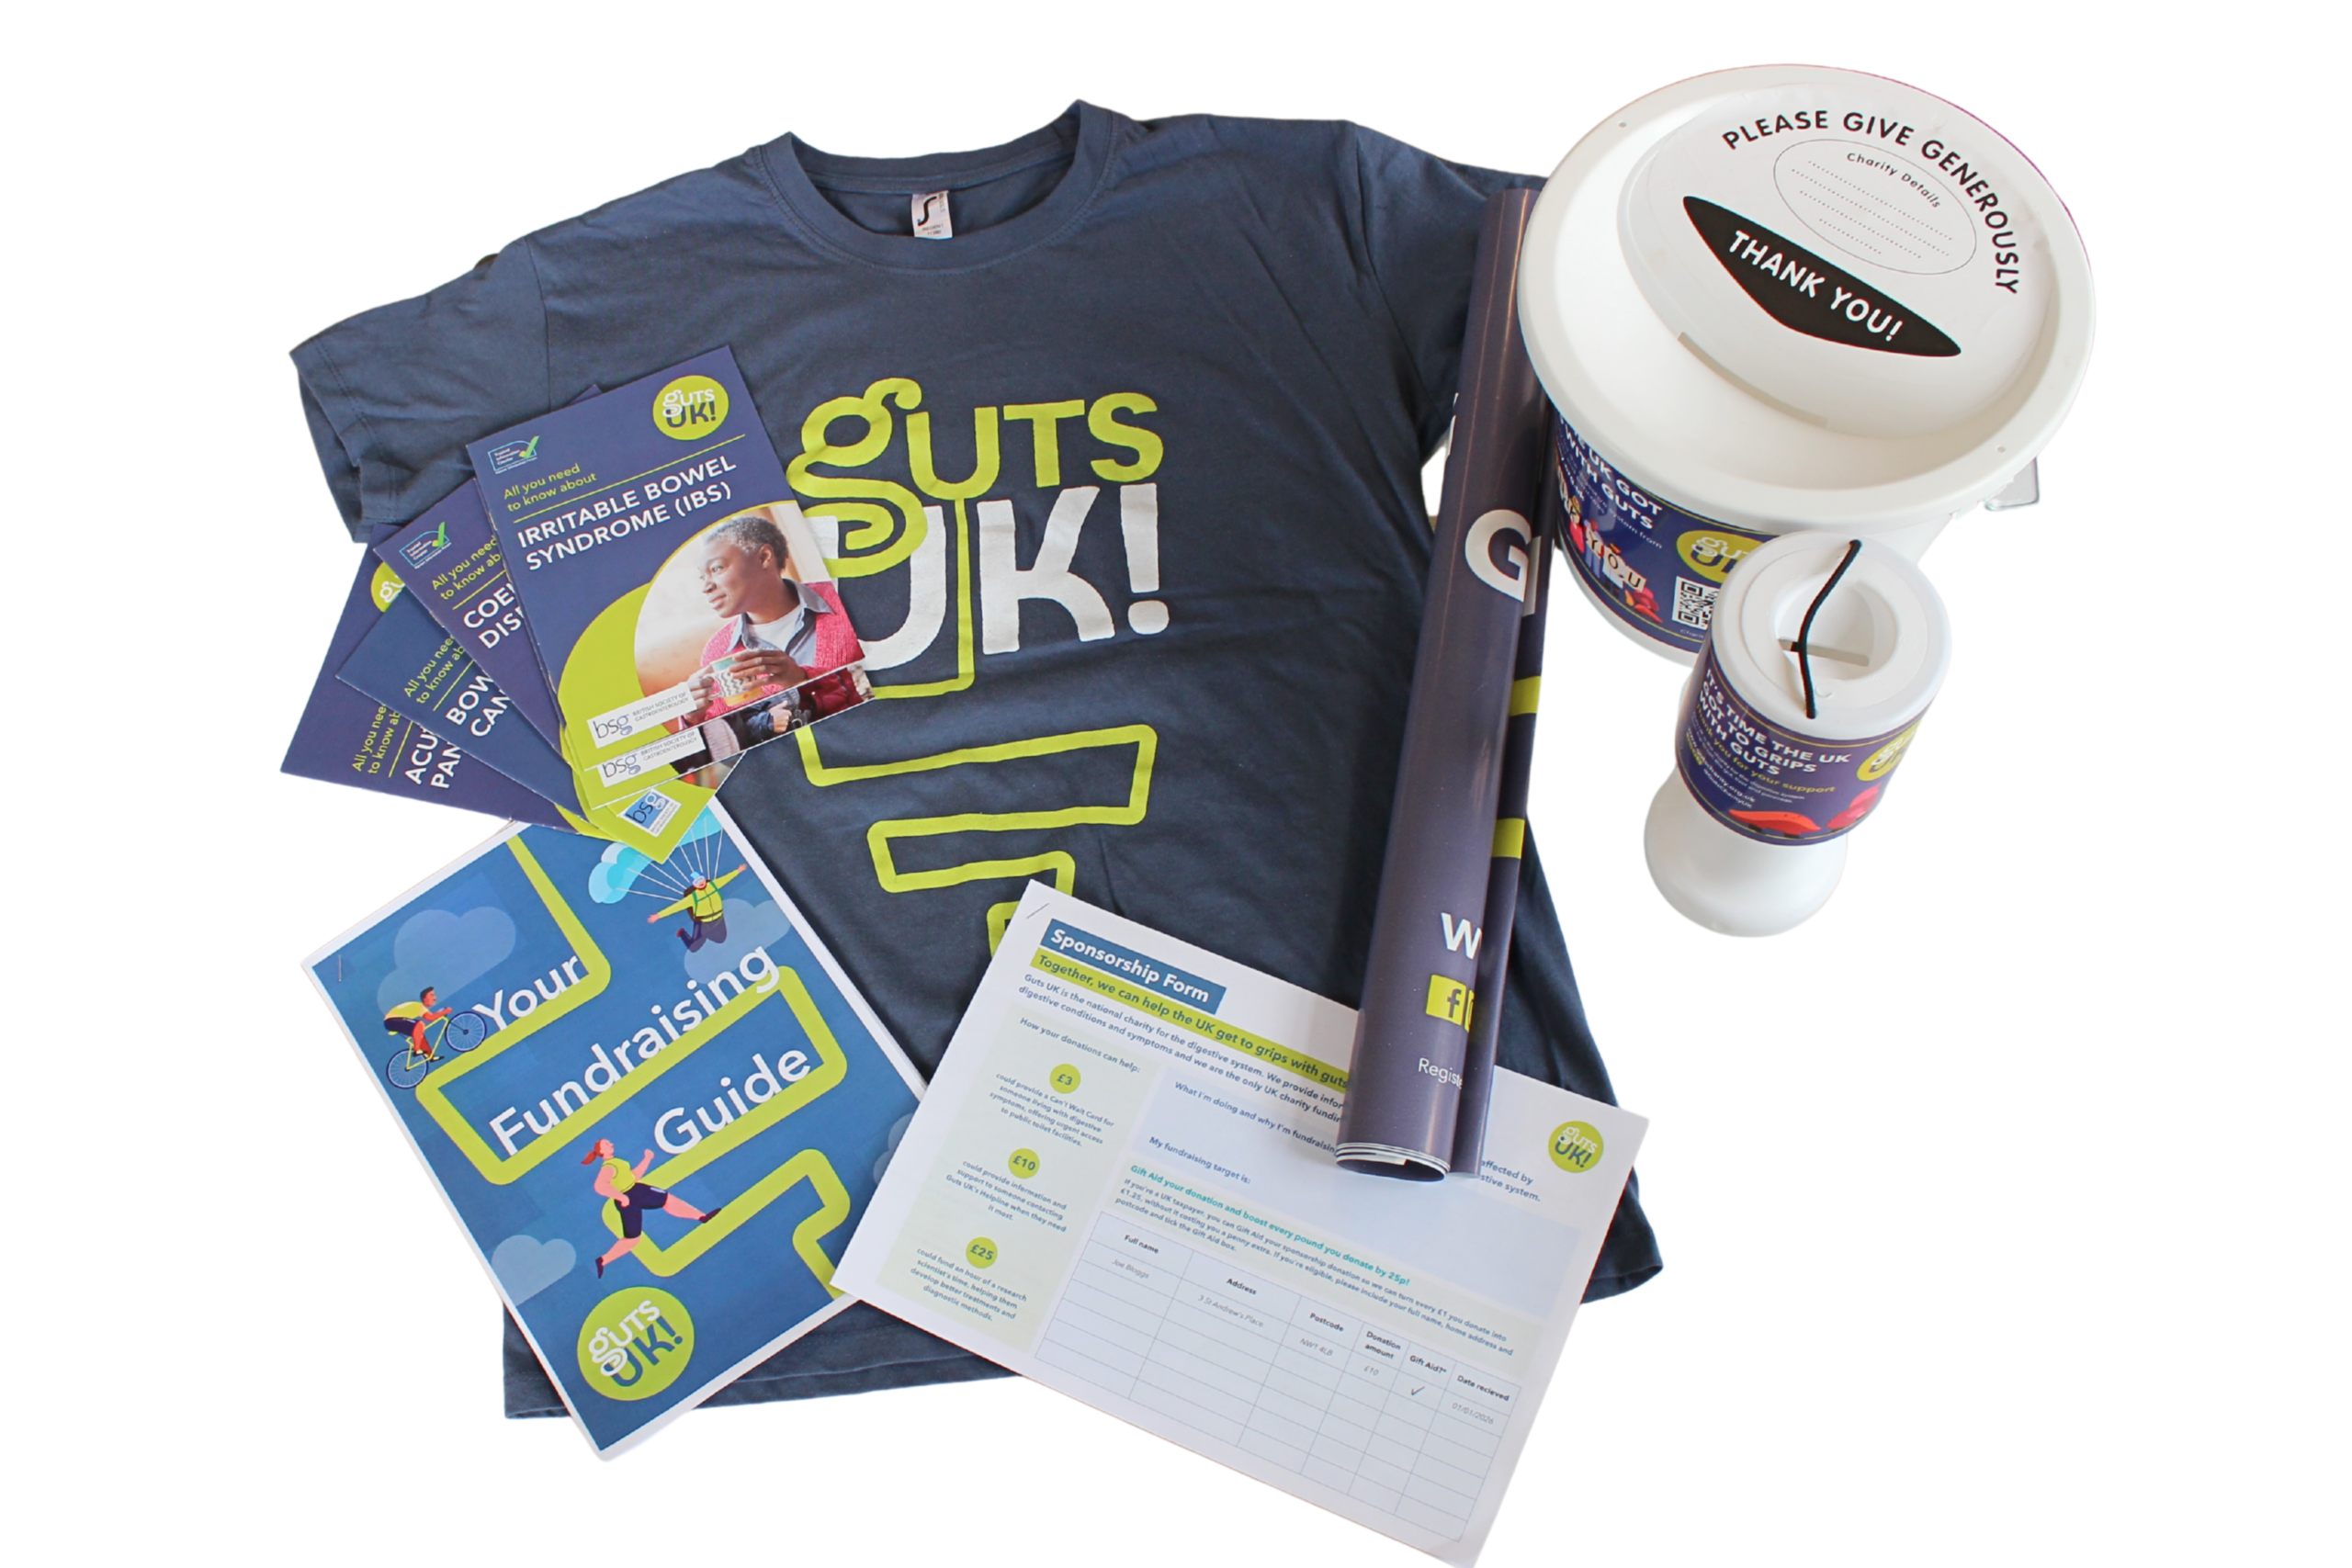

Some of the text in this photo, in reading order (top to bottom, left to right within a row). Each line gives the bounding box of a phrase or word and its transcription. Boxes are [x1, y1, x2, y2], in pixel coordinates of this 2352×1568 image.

[1721, 109, 2021, 295] PLEASE GIVE GENEROUSLY
[1847, 152, 1941, 209] Charity Details
[1728, 231, 1904, 342] THANK YOU!
[503, 484, 520, 500] All
[521, 477, 550, 494] you
[548, 462, 581, 482] need
[507, 472, 597, 512] to know about
[517, 456, 737, 547] IRRITABLE BOWEL
[1566, 424, 1598, 483] WITH
[1601, 483, 1653, 529] GUTS
[1616, 479, 1662, 514] GOT
[526, 481, 731, 570] SYNDROME (IBS)
[432, 572, 448, 590] All
[447, 558, 470, 581] you
[440, 589, 455, 600] to
[452, 564, 485, 590] know
[403, 634, 454, 697] All you nee
[415, 691, 430, 704] to
[424, 660, 454, 691] know
[593, 714, 633, 739] bsg
[631, 704, 654, 716] BRITISH
[654, 694, 678, 707] SOCIETY
[1703, 682, 1817, 773] GOT TO GRIPS
[1706, 669, 1724, 705] IT'S
[1726, 705, 1767, 745] TIME
[1771, 740, 1814, 761] THE
[1819, 753, 1852, 763] UK
[351, 702, 387, 772] All you nee
[371, 727, 394, 759] know
[404, 728, 438, 784] ACU
[1700, 691, 1780, 774] WITH GUTS
[367, 761, 380, 773] to
[1713, 739, 1731, 758] you
[1733, 757, 1748, 770] for
[1750, 771, 1780, 785] your
[1782, 783, 1835, 794] support
[473, 955, 580, 1031] Your
[1050, 929, 1209, 1003] Sponsorship Form
[1023, 974, 1045, 987] Guts
[1046, 982, 1060, 994] UK
[1060, 988, 1069, 998] is
[1069, 992, 1085, 1004] the
[1086, 1000, 1124, 1020] national
[1123, 1015, 1155, 1033] charity
[1155, 1027, 1170, 1038] for
[1170, 1034, 1186, 1045] the
[1186, 1041, 1229, 1063] digestive
[1229, 1059, 1263, 1077] system.
[1266, 1072, 1282, 1084] We
[1281, 1080, 1319, 1100] provide
[1039, 954, 1093, 987] Together,
[1097, 980, 1115, 994] we
[1117, 989, 1139, 1003] can
[1141, 996, 1170, 1017] help
[1172, 1010, 1193, 1025] the
[1194, 1018, 1216, 1034] UK
[1215, 1029, 1238, 1043] get
[1239, 1037, 1253, 1049] to
[1254, 1045, 1288, 1064] grips
[1290, 1058, 1318, 1077] with
[491, 946, 780, 1156] Fundraising
[1019, 1017, 1140, 1073] How your donations can help:
[653, 1050, 811, 1156] Guide
[995, 1073, 1016, 1086] could
[1014, 1082, 1043, 1098] provide
[1049, 1095, 1069, 1108] Can't
[1068, 1102, 1085, 1115] Wait
[1085, 1111, 1103, 1122] Card
[1102, 1118, 1114, 1127] for
[1056, 1073, 1073, 1086] £3
[1174, 1081, 1338, 1153] What I'm doing and why I'm fundraisin
[1012, 1155, 1035, 1171] £10
[1148, 1136, 1250, 1184] My fundraising target is:
[969, 1244, 994, 1260] £25
[1124, 1235, 1159, 1254] Full name
[1226, 1278, 1257, 1295] Address
[1309, 1312, 1344, 1332] Postcode
[1365, 1330, 1401, 1350] Donation
[1364, 1344, 1394, 1359] amount
[1409, 1355, 1424, 1366] Gift
[1456, 1374, 1510, 1402] Date recieved
